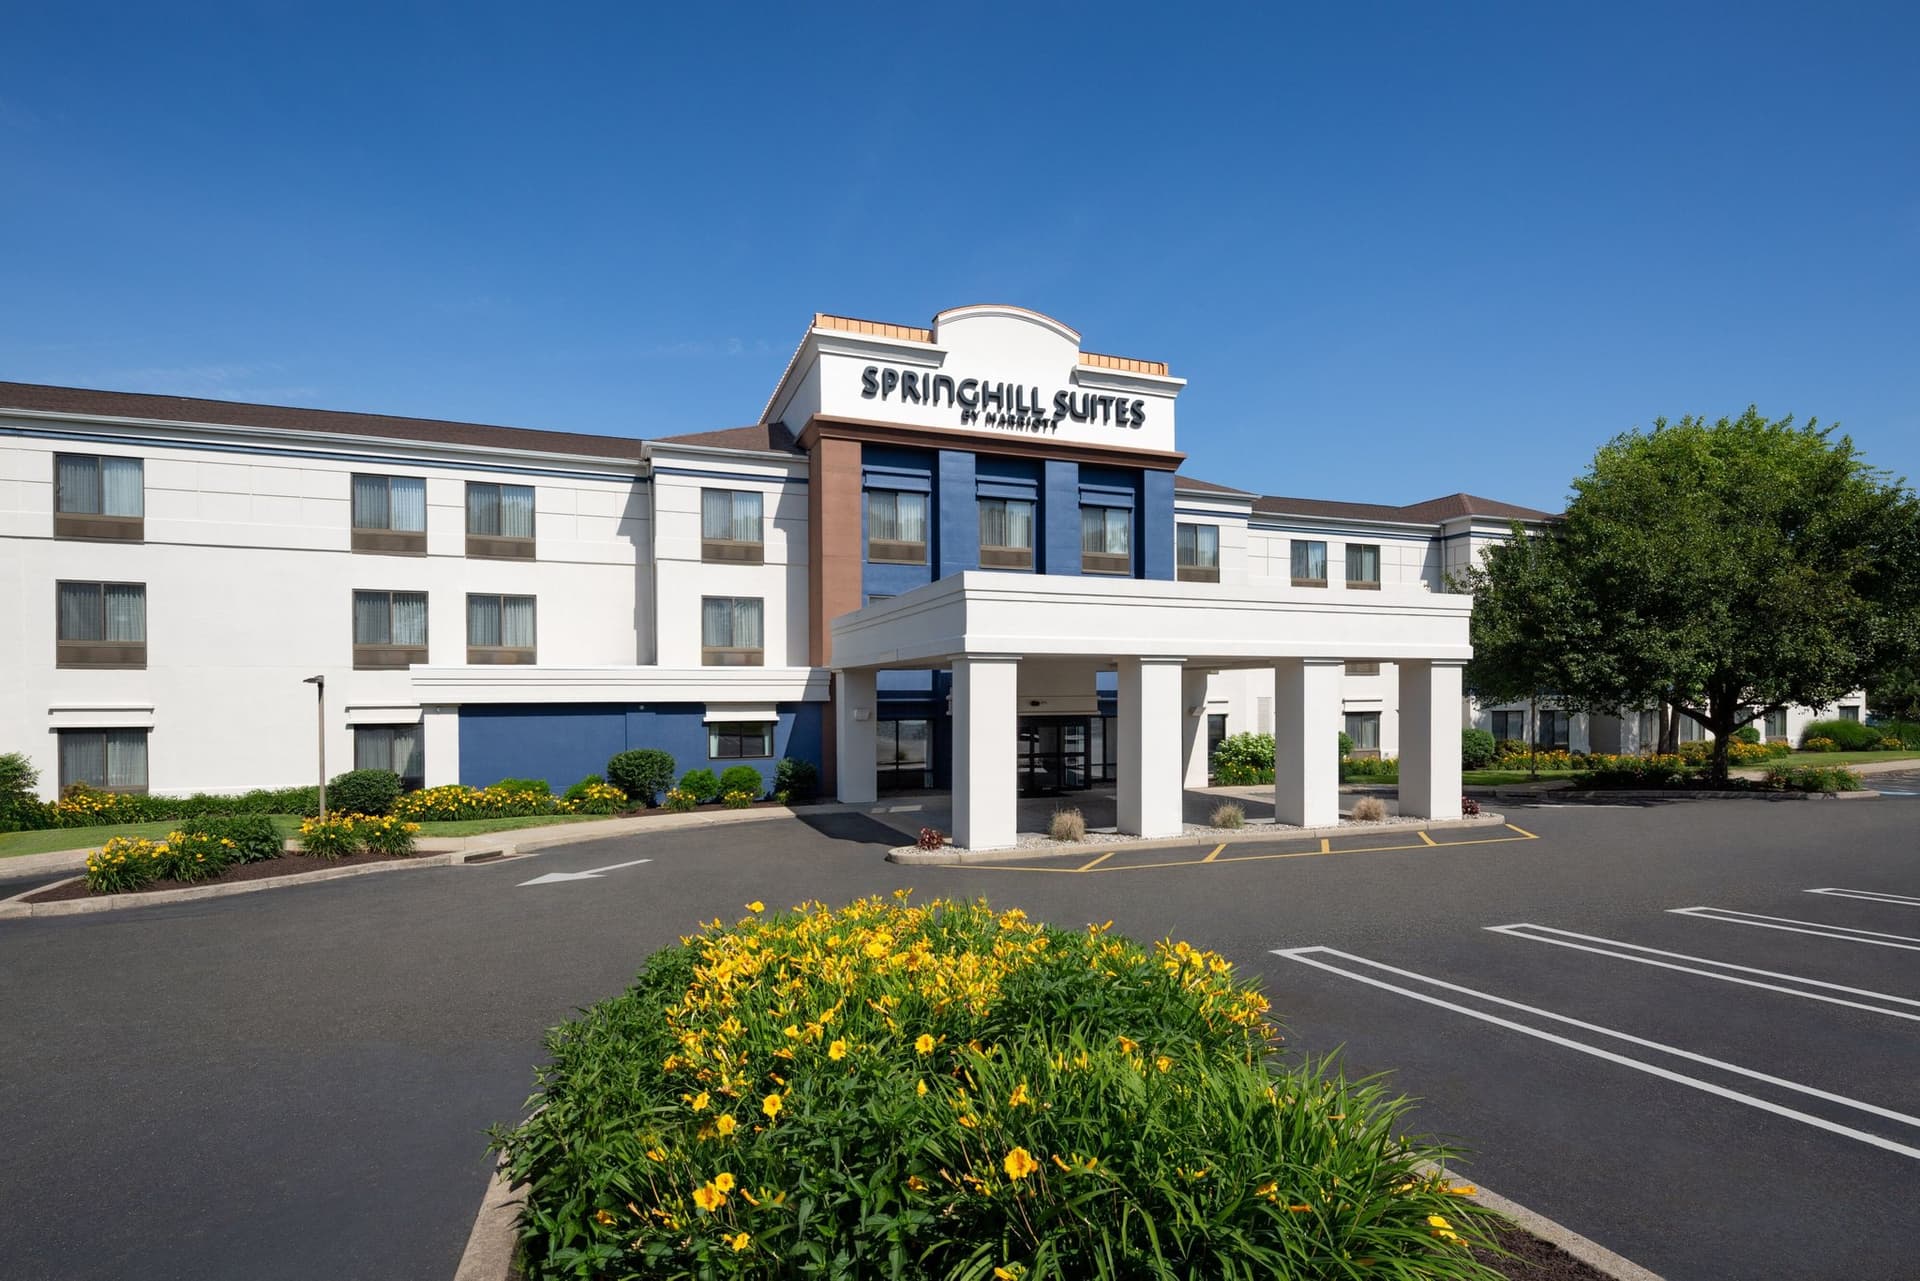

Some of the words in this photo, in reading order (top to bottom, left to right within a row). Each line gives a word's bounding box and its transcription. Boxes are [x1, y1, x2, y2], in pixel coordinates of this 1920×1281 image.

[861, 366, 1046, 415] SPRINGHILL
[1053, 390, 1146, 429] SUITES
[960, 408, 980, 425] BY
[984, 412, 1060, 434] MARRIOTT
